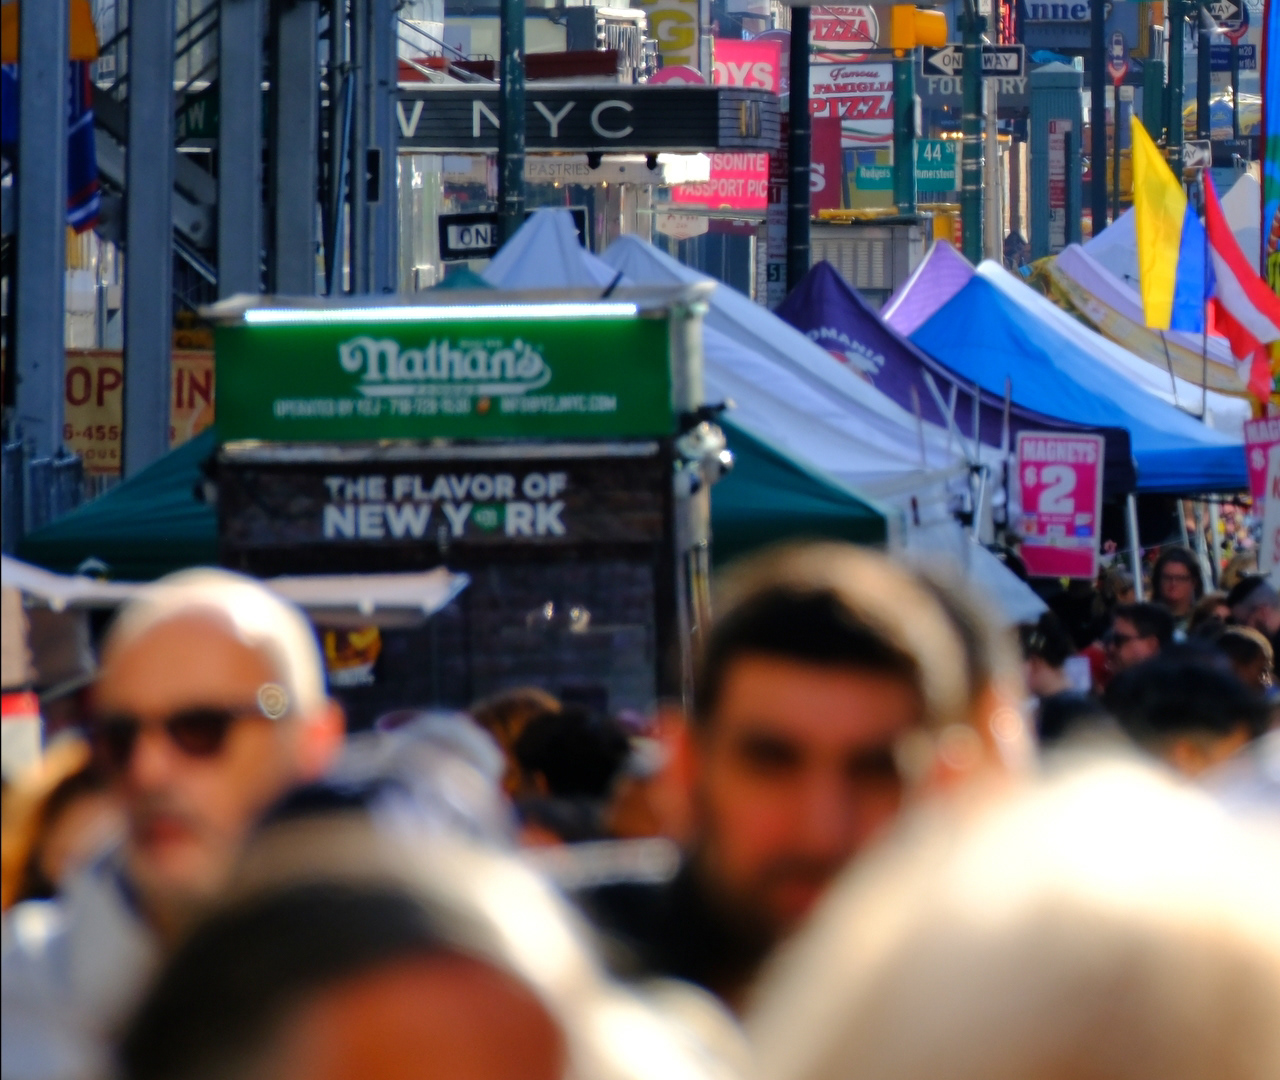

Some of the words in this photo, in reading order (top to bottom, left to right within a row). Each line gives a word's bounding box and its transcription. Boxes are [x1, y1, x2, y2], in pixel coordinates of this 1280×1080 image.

[1211, 3, 1231, 15] WAY
[983, 53, 1013, 66] WAY
[829, 68, 881, 81] Famous
[472, 99, 633, 139] NYC
[923, 143, 942, 161] 44
[945, 143, 956, 154] St
[528, 163, 591, 176] PASTRIES
[860, 167, 891, 181] Rodgers
[678, 178, 744, 199] PASSPORT
[338, 335, 545, 381] Nathan's
[1022, 439, 1097, 465] MAGNETS
[323, 476, 387, 502] THE
[392, 474, 517, 501] FLAVOR
[521, 473, 568, 498] OF
[322, 502, 433, 539] NEW
